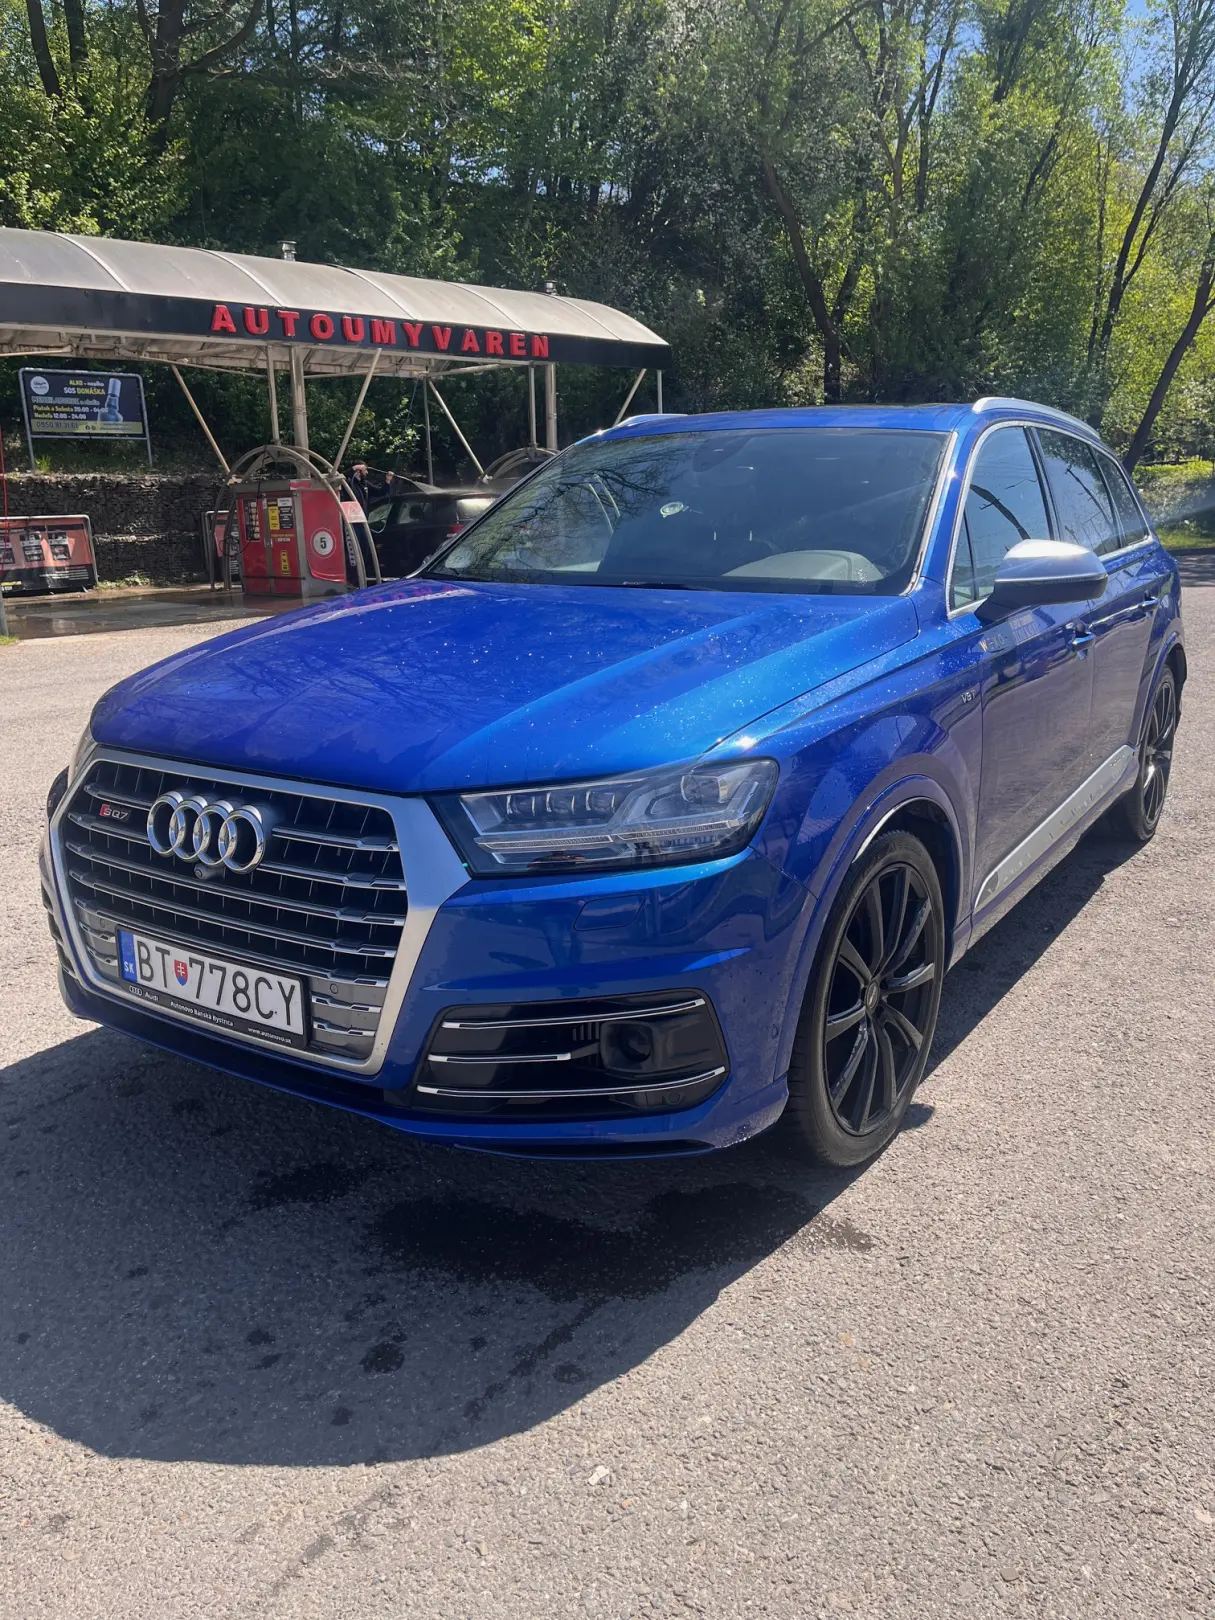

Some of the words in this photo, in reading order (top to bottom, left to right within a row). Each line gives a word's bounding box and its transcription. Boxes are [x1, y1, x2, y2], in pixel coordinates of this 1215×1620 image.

[77, 386, 105, 395] DONÁŠKA
[319, 536, 327, 549] 5
[101, 806, 128, 820] SQ7
[124, 960, 135, 974] SK
[136, 940, 171, 989] BT
[188, 956, 296, 1026] 778CY
[144, 991, 159, 1002] Audi
[170, 1001, 193, 1014] Autonovo
[212, 1015, 234, 1027] Bystrica
